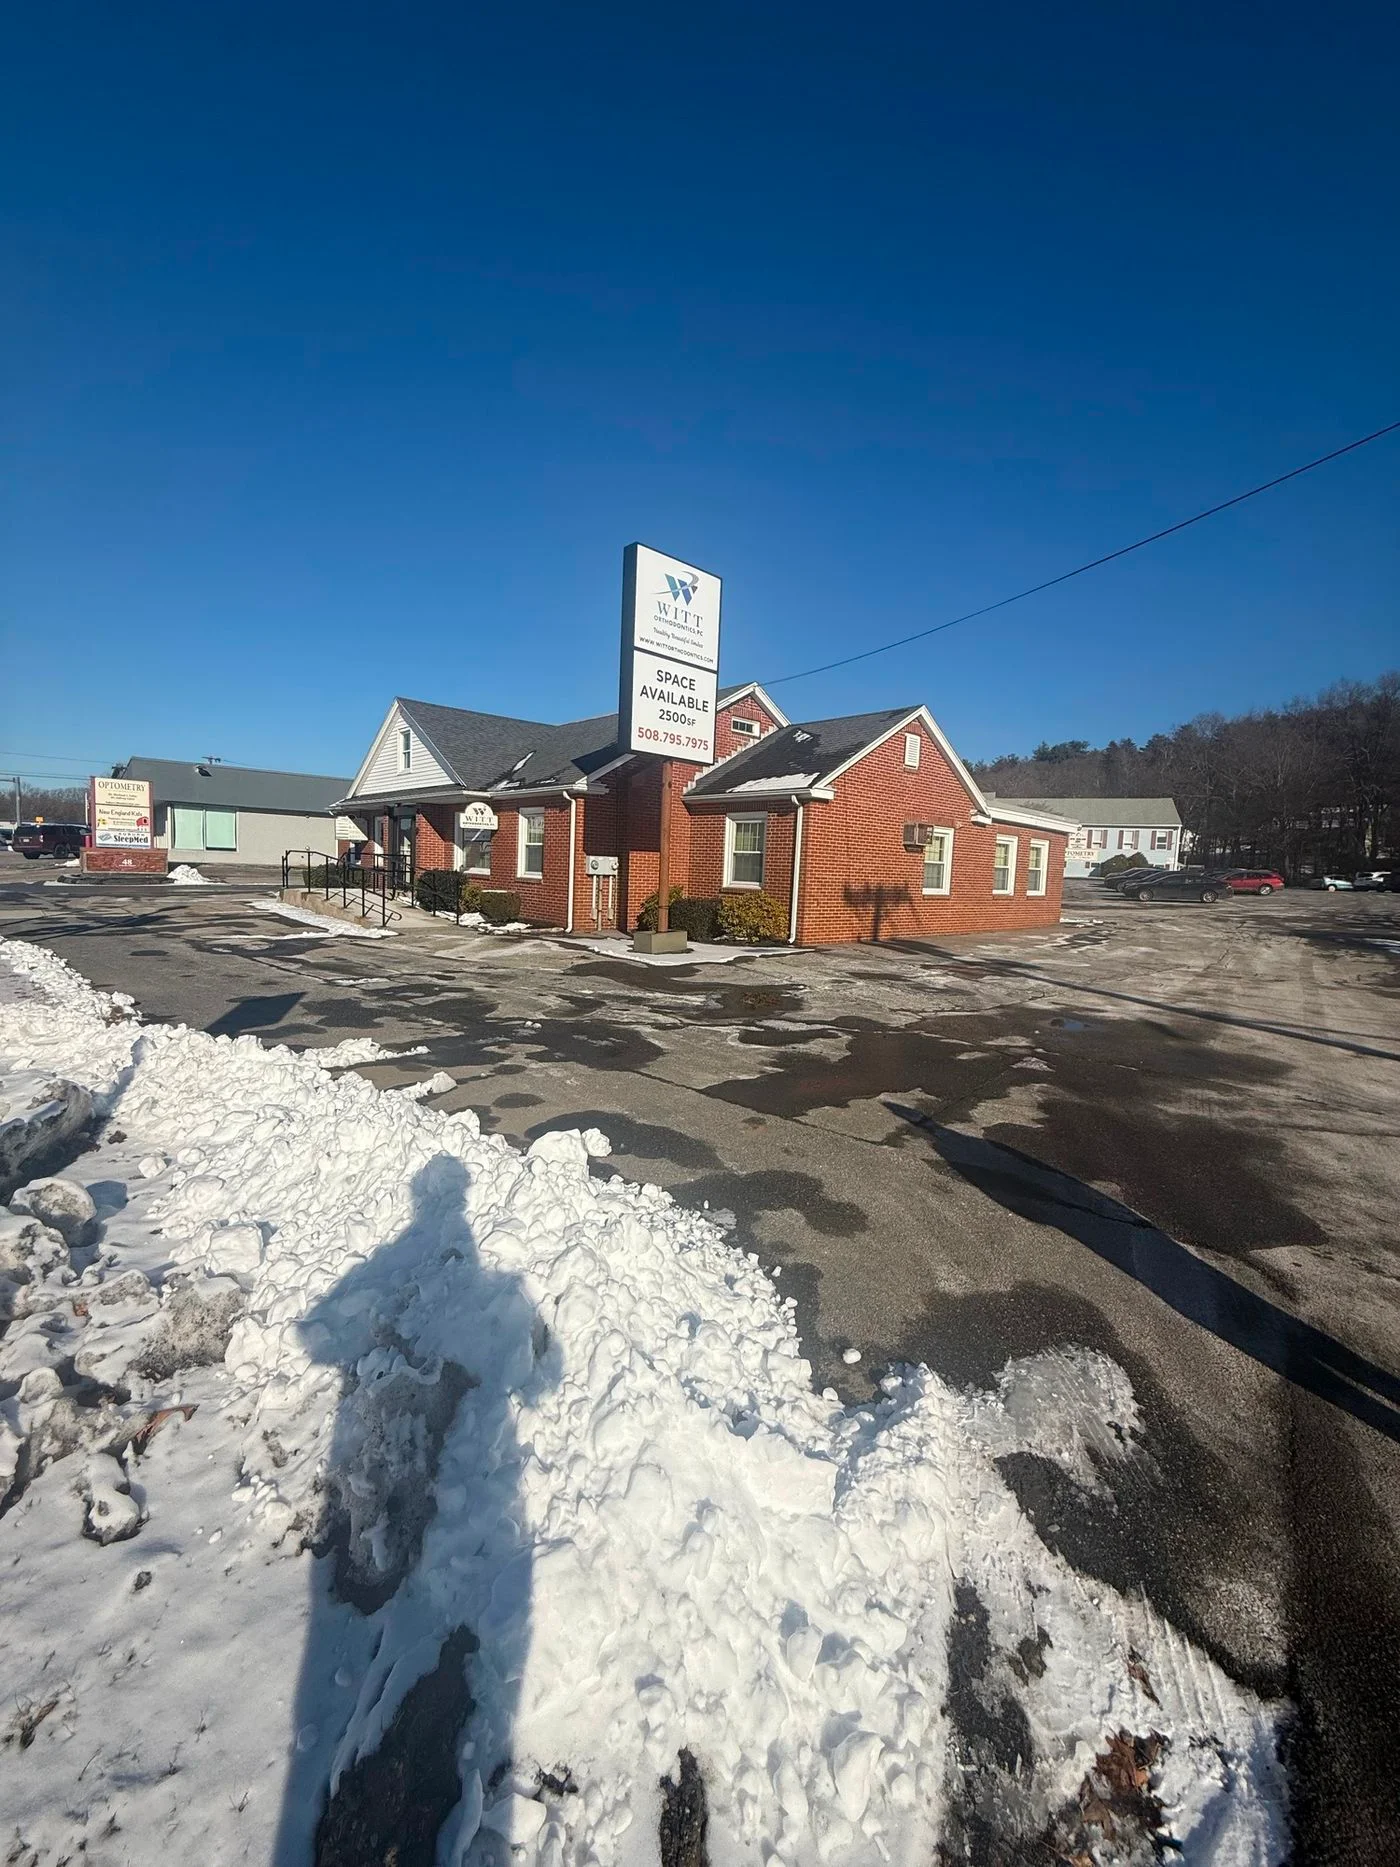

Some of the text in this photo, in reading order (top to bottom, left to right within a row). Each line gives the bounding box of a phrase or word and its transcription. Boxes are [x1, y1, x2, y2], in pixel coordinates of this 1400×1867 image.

[656, 600, 704, 629] WITT
[639, 636, 714, 664] WWW.WITTORTHODONTICS.COM
[656, 669, 696, 691] SPACE
[640, 685, 709, 713] AVAILABLE
[637, 726, 709, 751] 508.795.7975
[98, 781, 146, 791] OPTOMETRY
[111, 810, 131, 818] England
[113, 835, 149, 843] SleepMed
